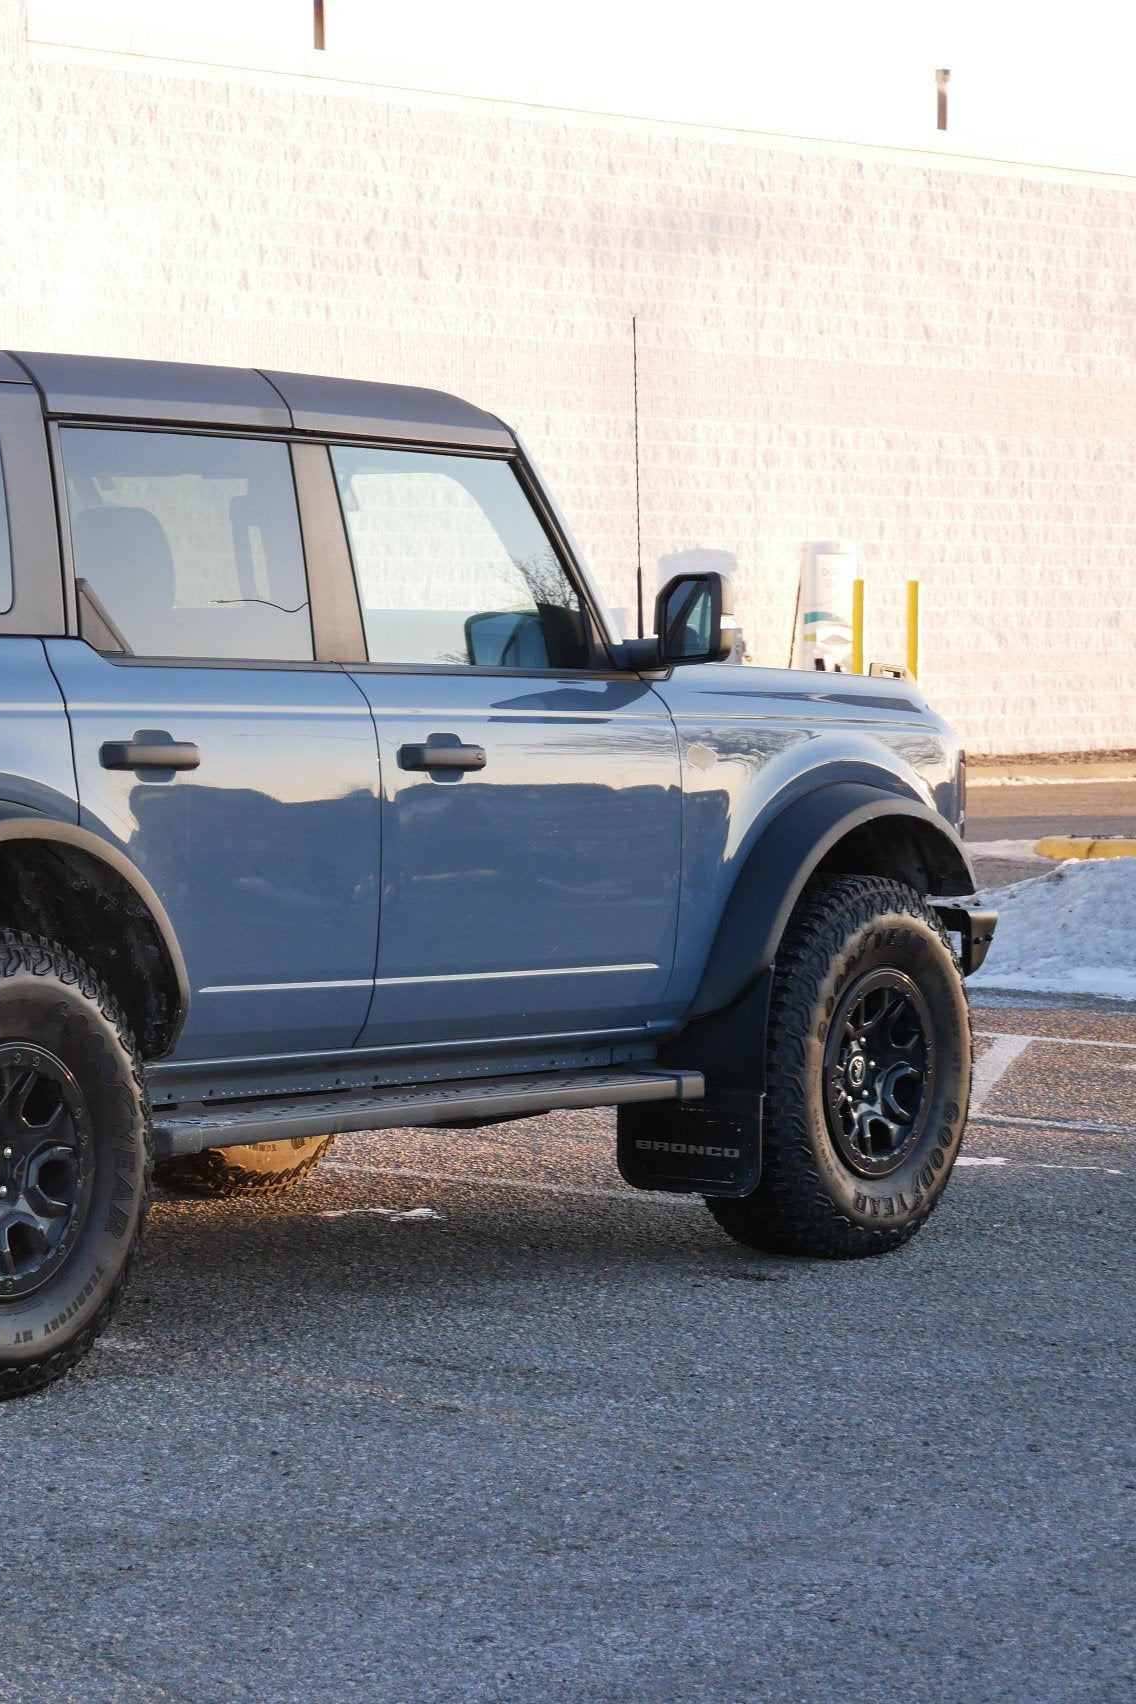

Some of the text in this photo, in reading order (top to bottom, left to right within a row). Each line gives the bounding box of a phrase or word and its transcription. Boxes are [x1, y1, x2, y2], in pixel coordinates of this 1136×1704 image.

[635, 1139, 740, 1158] BRONCO
[852, 1101, 960, 1217] GOODYEAR
[44, 1265, 104, 1336] TERRITORY
